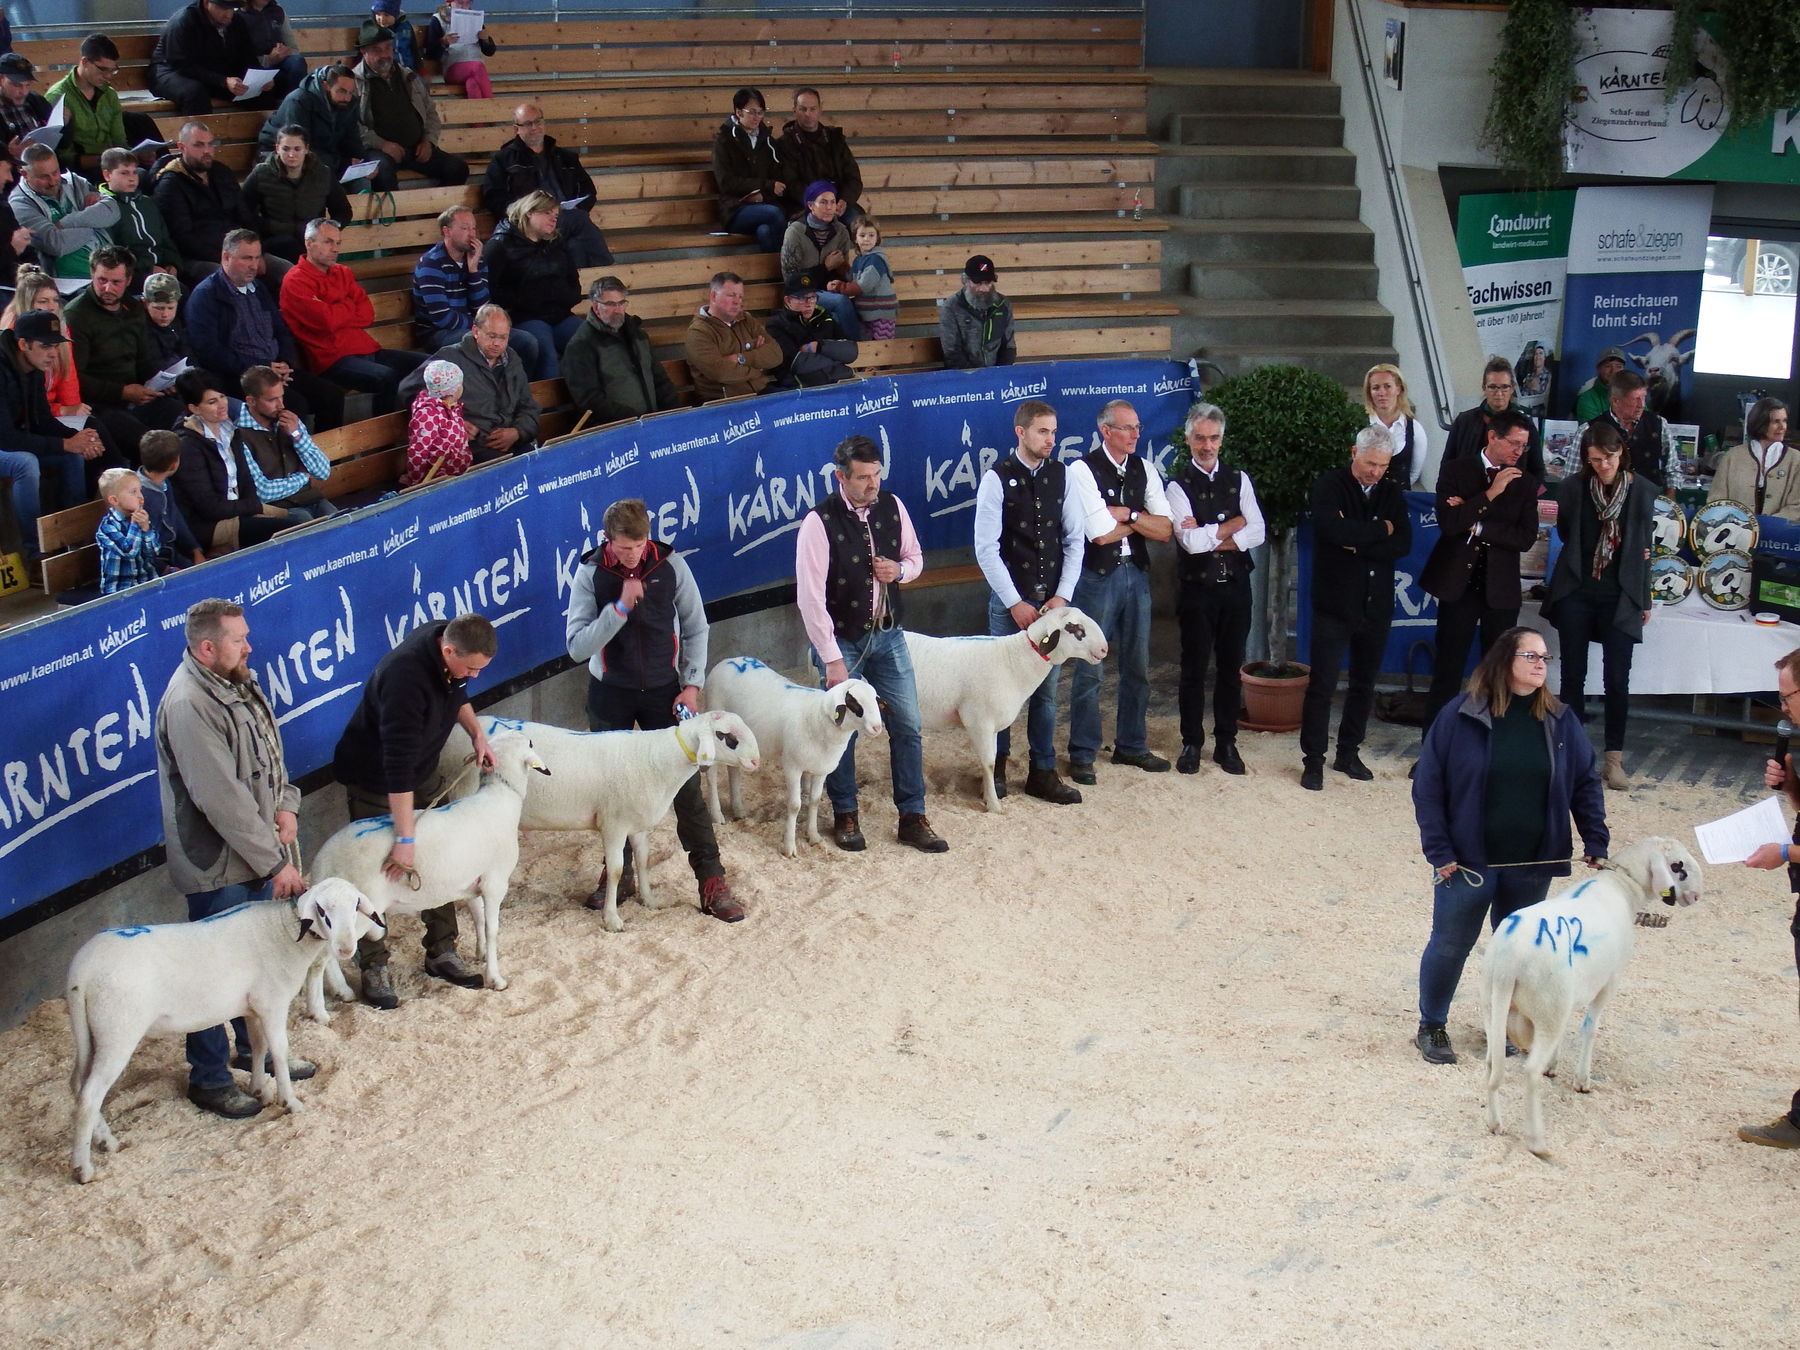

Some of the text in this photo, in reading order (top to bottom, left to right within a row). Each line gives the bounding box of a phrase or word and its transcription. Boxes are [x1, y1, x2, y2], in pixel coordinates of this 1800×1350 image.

[1635, 109, 1650, 117] und
[1488, 213, 1552, 238] Landwirt
[1492, 240, 1549, 249] landwirt-media.com
[1594, 293, 1678, 309] Reinschauen
[1476, 310, 1545, 328] eit über 100 Jahren!
[1592, 311, 1662, 328] lohnt sich!
[303, 544, 379, 581] www.kaernten.at
[427, 500, 491, 534] www.kaernten.at
[538, 465, 601, 494] www.kaernten.at
[649, 432, 719, 459] www.kaernten.at
[773, 406, 849, 428] www.kaernten.at
[912, 390, 995, 408] www.kaernten.at
[1061, 383, 1147, 396] www.kaernten.at
[1, 645, 94, 691] www.kaernten.at
